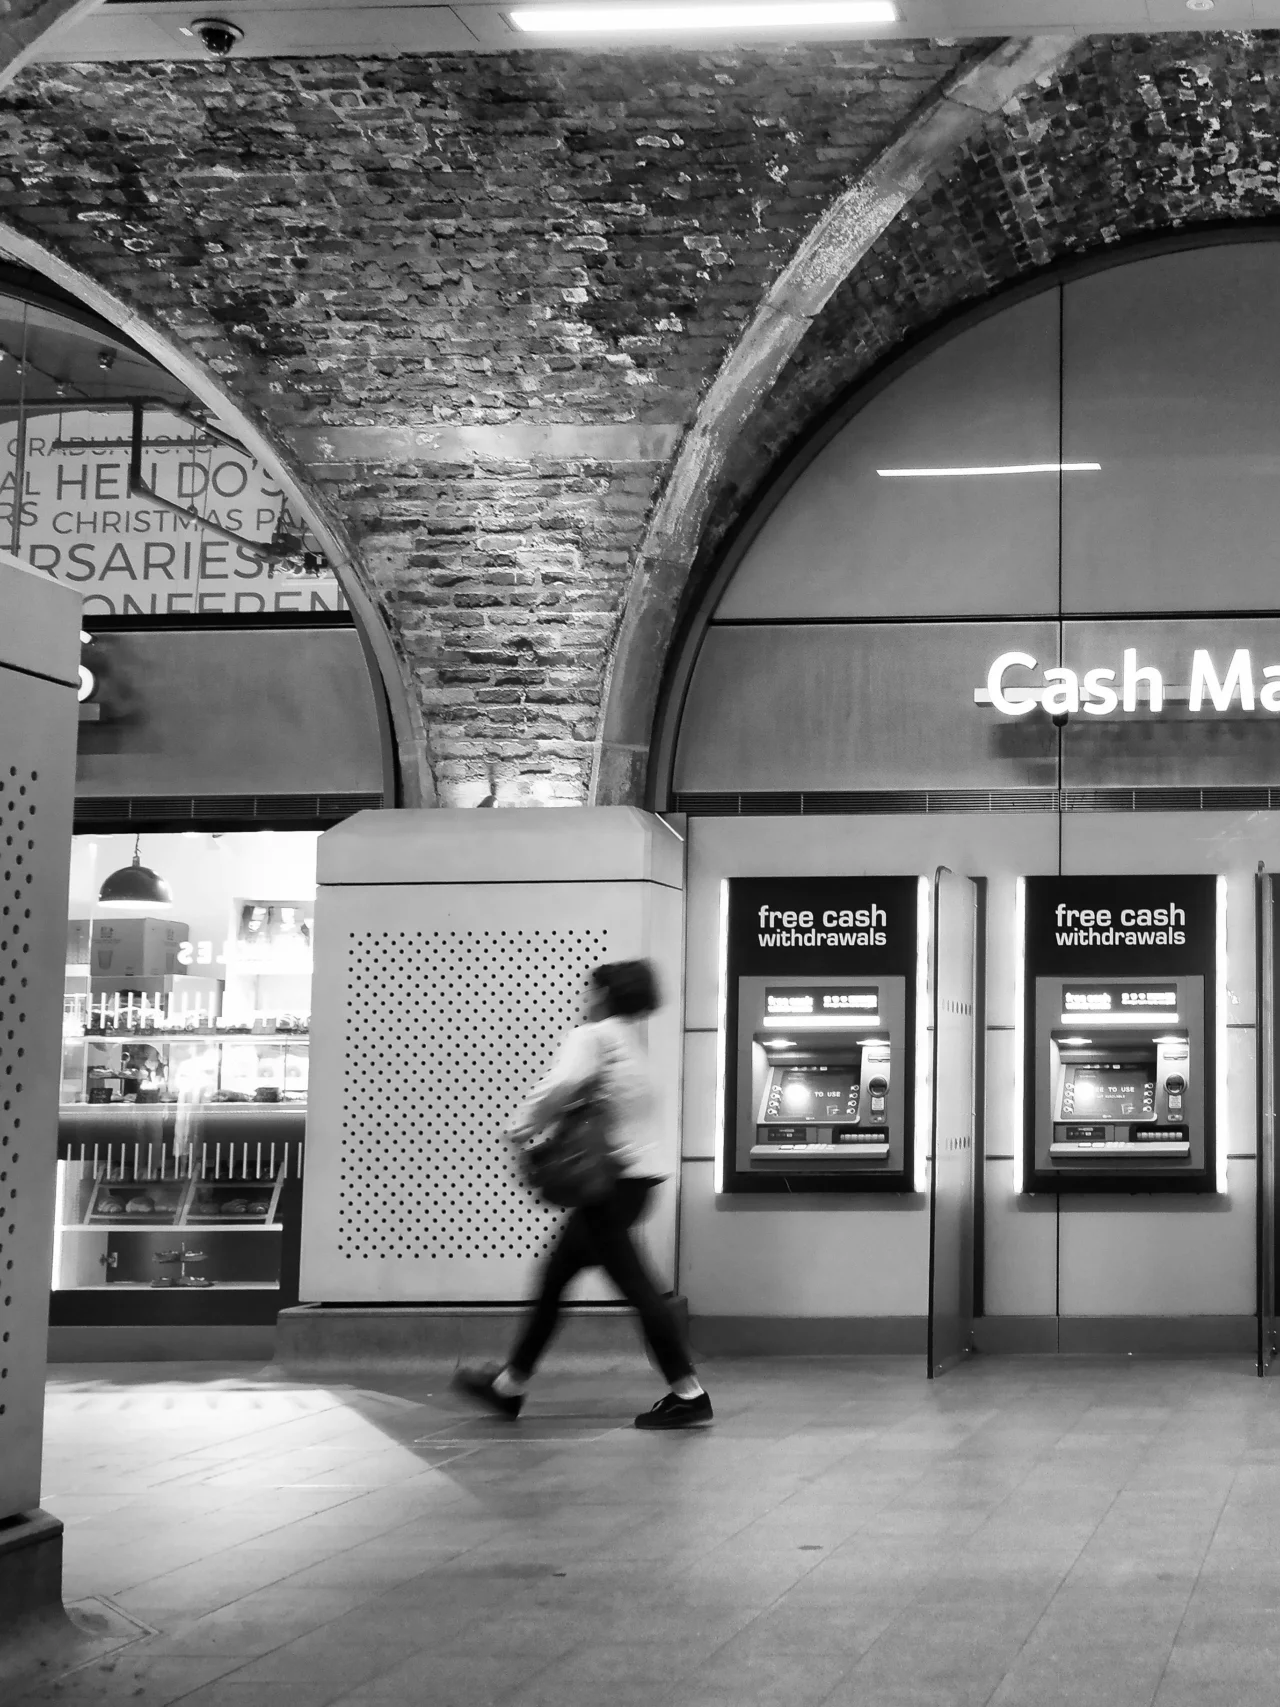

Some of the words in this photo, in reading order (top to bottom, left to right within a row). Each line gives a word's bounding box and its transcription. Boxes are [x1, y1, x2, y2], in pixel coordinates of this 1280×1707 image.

[7, 435, 212, 457] GRADUAIONS
[52, 509, 243, 534] CHRISTMAS
[0, 541, 264, 581] RSARIES
[987, 648, 1164, 715] Cash
[758, 905, 814, 928] free
[823, 904, 887, 927] cash
[1055, 903, 1111, 927] free
[1121, 902, 1185, 926] cash
[758, 928, 887, 947] withdrawals
[1055, 926, 1185, 946] withdrawals
